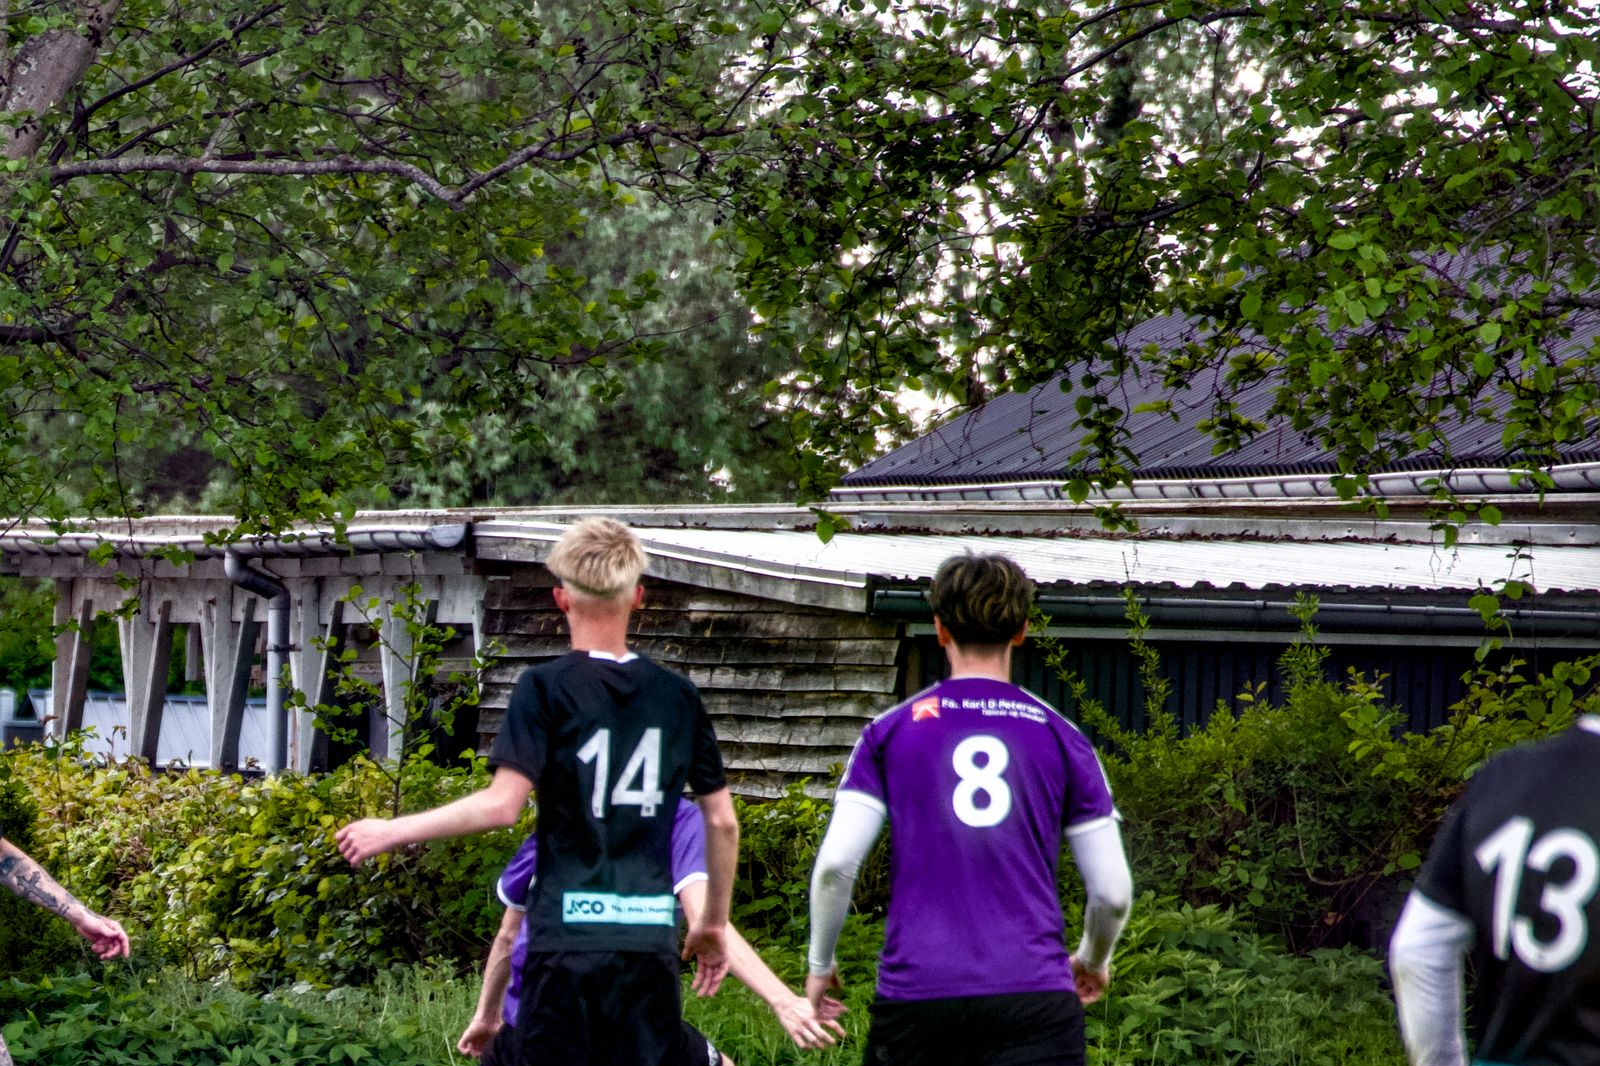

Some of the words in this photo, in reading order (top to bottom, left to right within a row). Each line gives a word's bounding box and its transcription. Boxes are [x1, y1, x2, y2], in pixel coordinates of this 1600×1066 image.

[576, 726, 664, 818] 14
[952, 734, 1012, 827] 8
[1475, 817, 1599, 972] 13
